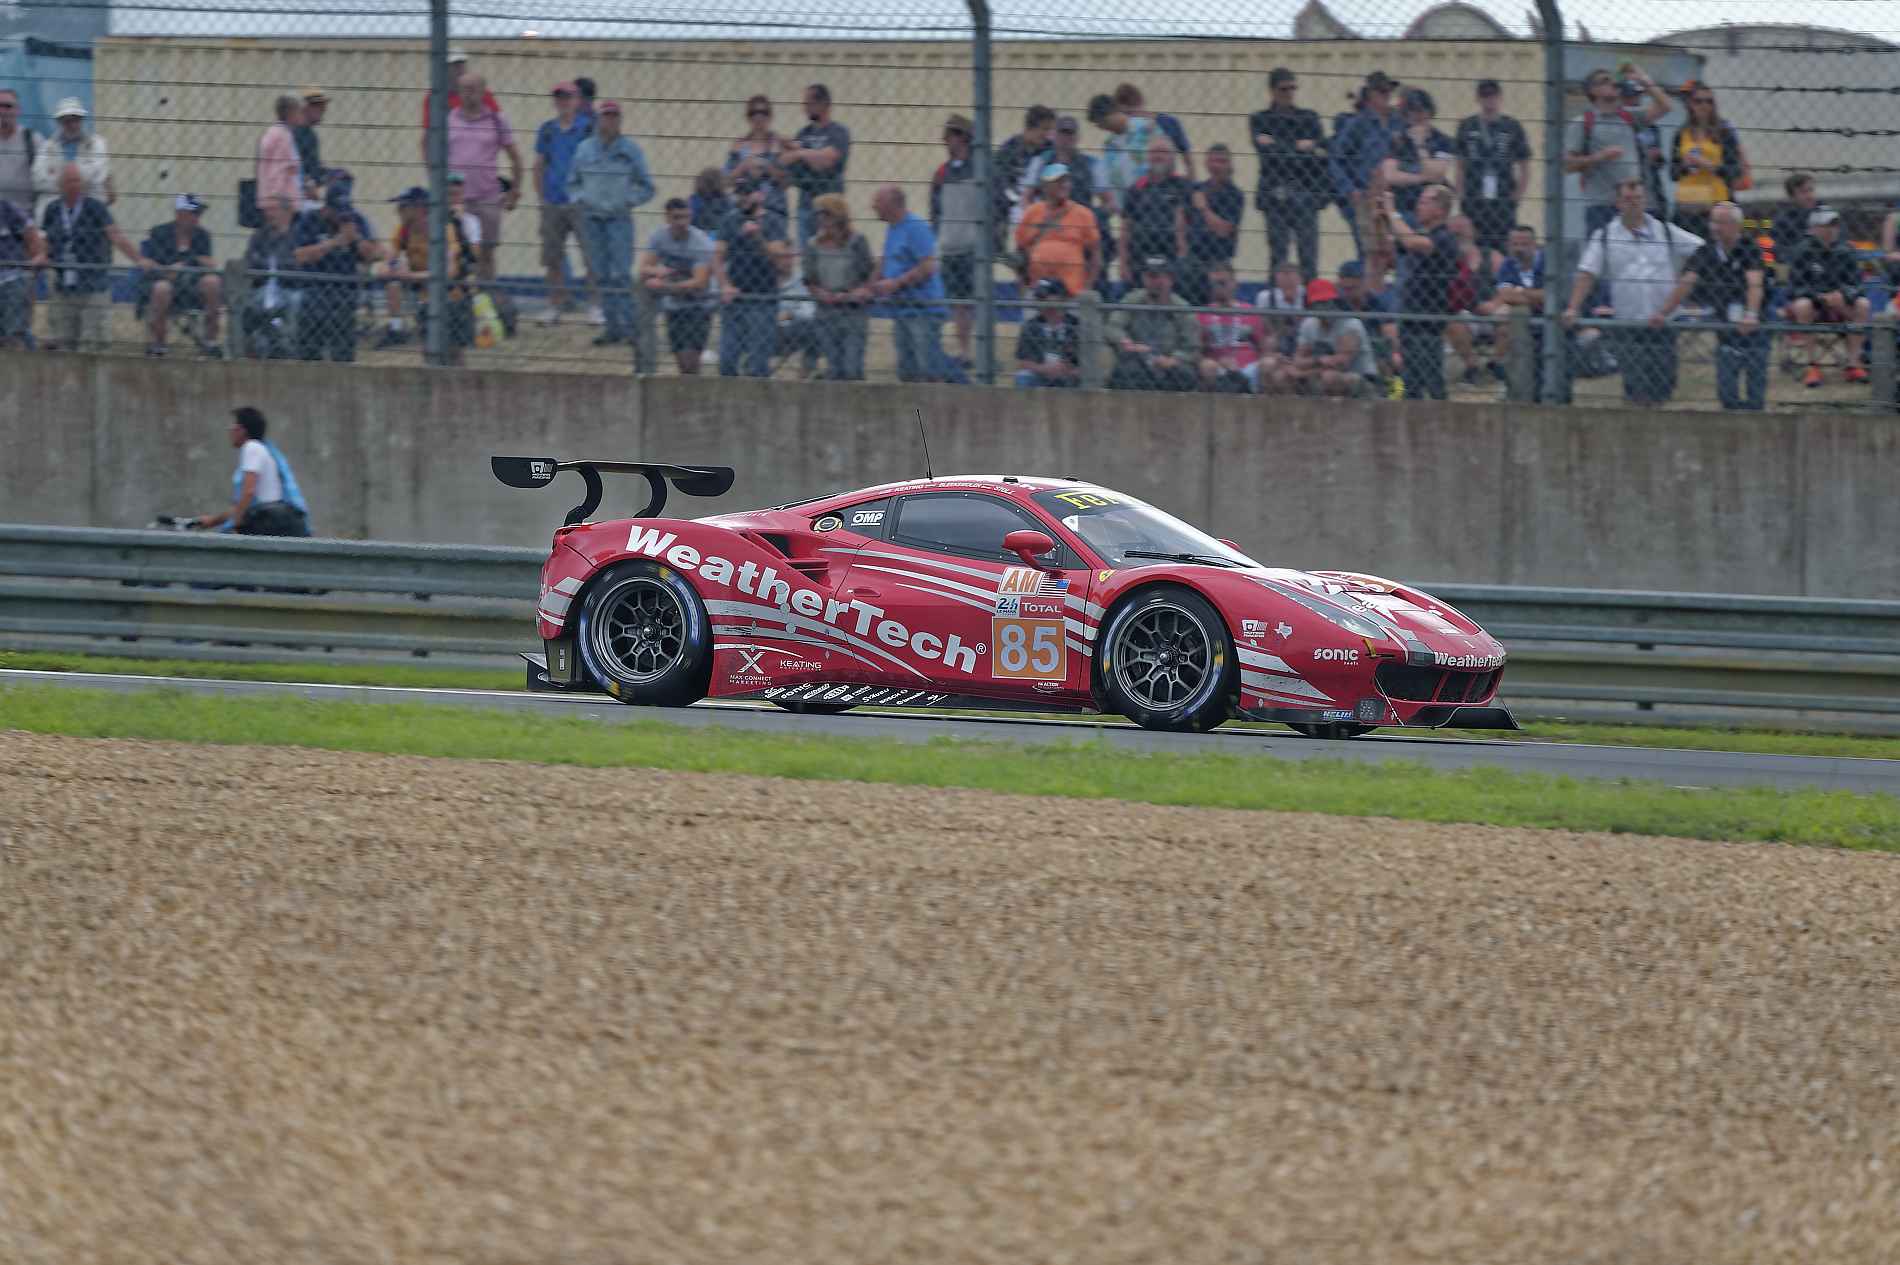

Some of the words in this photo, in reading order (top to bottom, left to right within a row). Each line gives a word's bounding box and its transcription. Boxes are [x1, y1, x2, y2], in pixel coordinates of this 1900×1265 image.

[852, 513, 884, 523] OMP
[1003, 569, 1041, 593] AM
[1021, 602, 1062, 613] TOTAL
[1000, 624, 1060, 673] 85
[779, 659, 822, 669] KEATING
